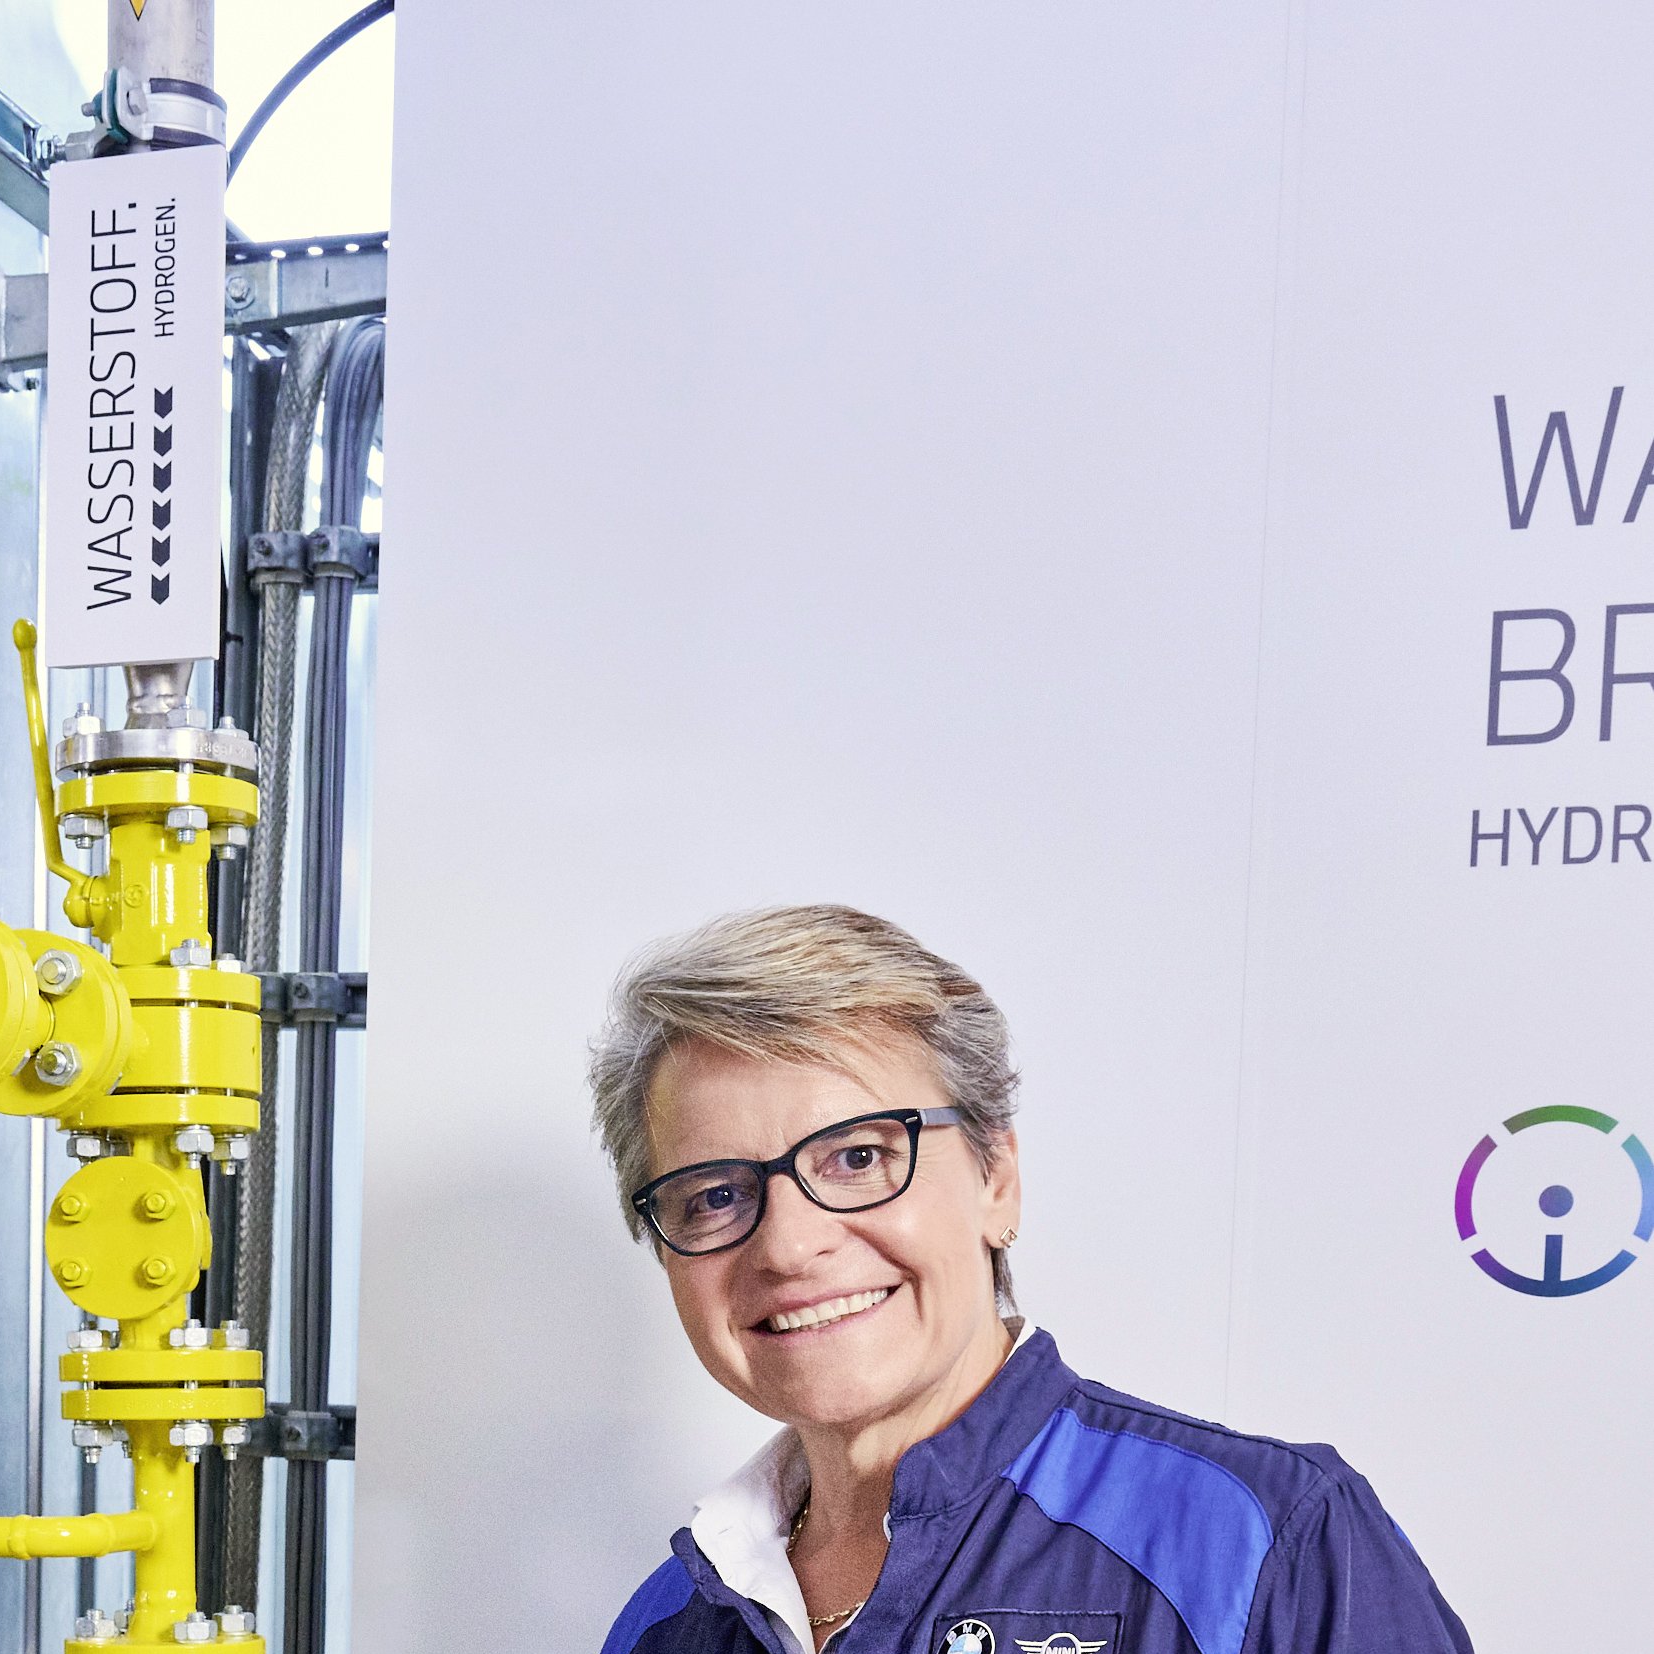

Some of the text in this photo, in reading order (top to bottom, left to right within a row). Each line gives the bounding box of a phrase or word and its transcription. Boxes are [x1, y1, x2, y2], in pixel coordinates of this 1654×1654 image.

[153, 197, 176, 338] HYDROGEN.
[86, 201, 138, 611] WASSERSTOFF.
[1470, 804, 1652, 867] HYDR
